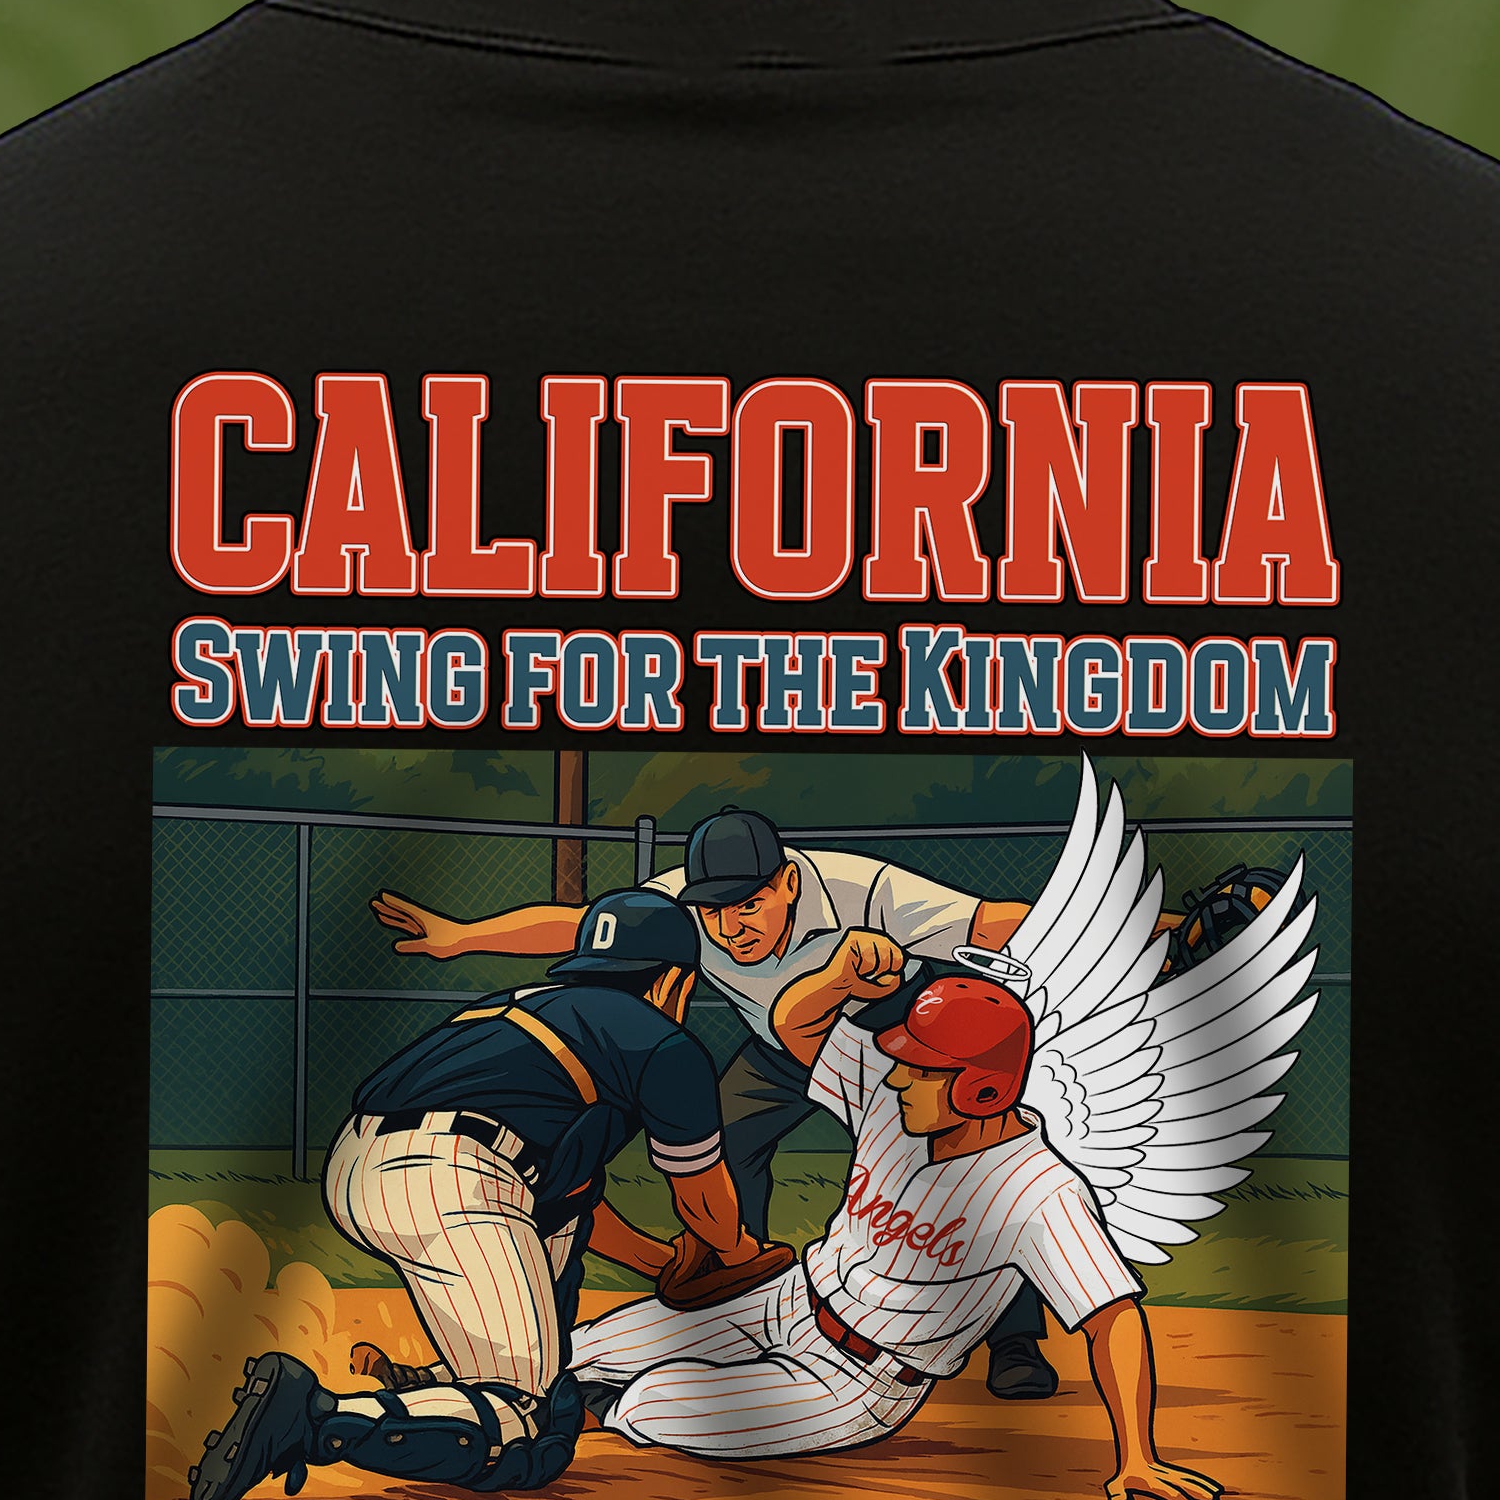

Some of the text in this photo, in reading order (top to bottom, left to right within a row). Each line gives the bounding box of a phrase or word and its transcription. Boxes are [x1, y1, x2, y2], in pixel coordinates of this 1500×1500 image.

[170, 372, 1340, 606] CALIFORNIA
[591, 912, 618, 950] D
[847, 1163, 967, 1268] Angels
